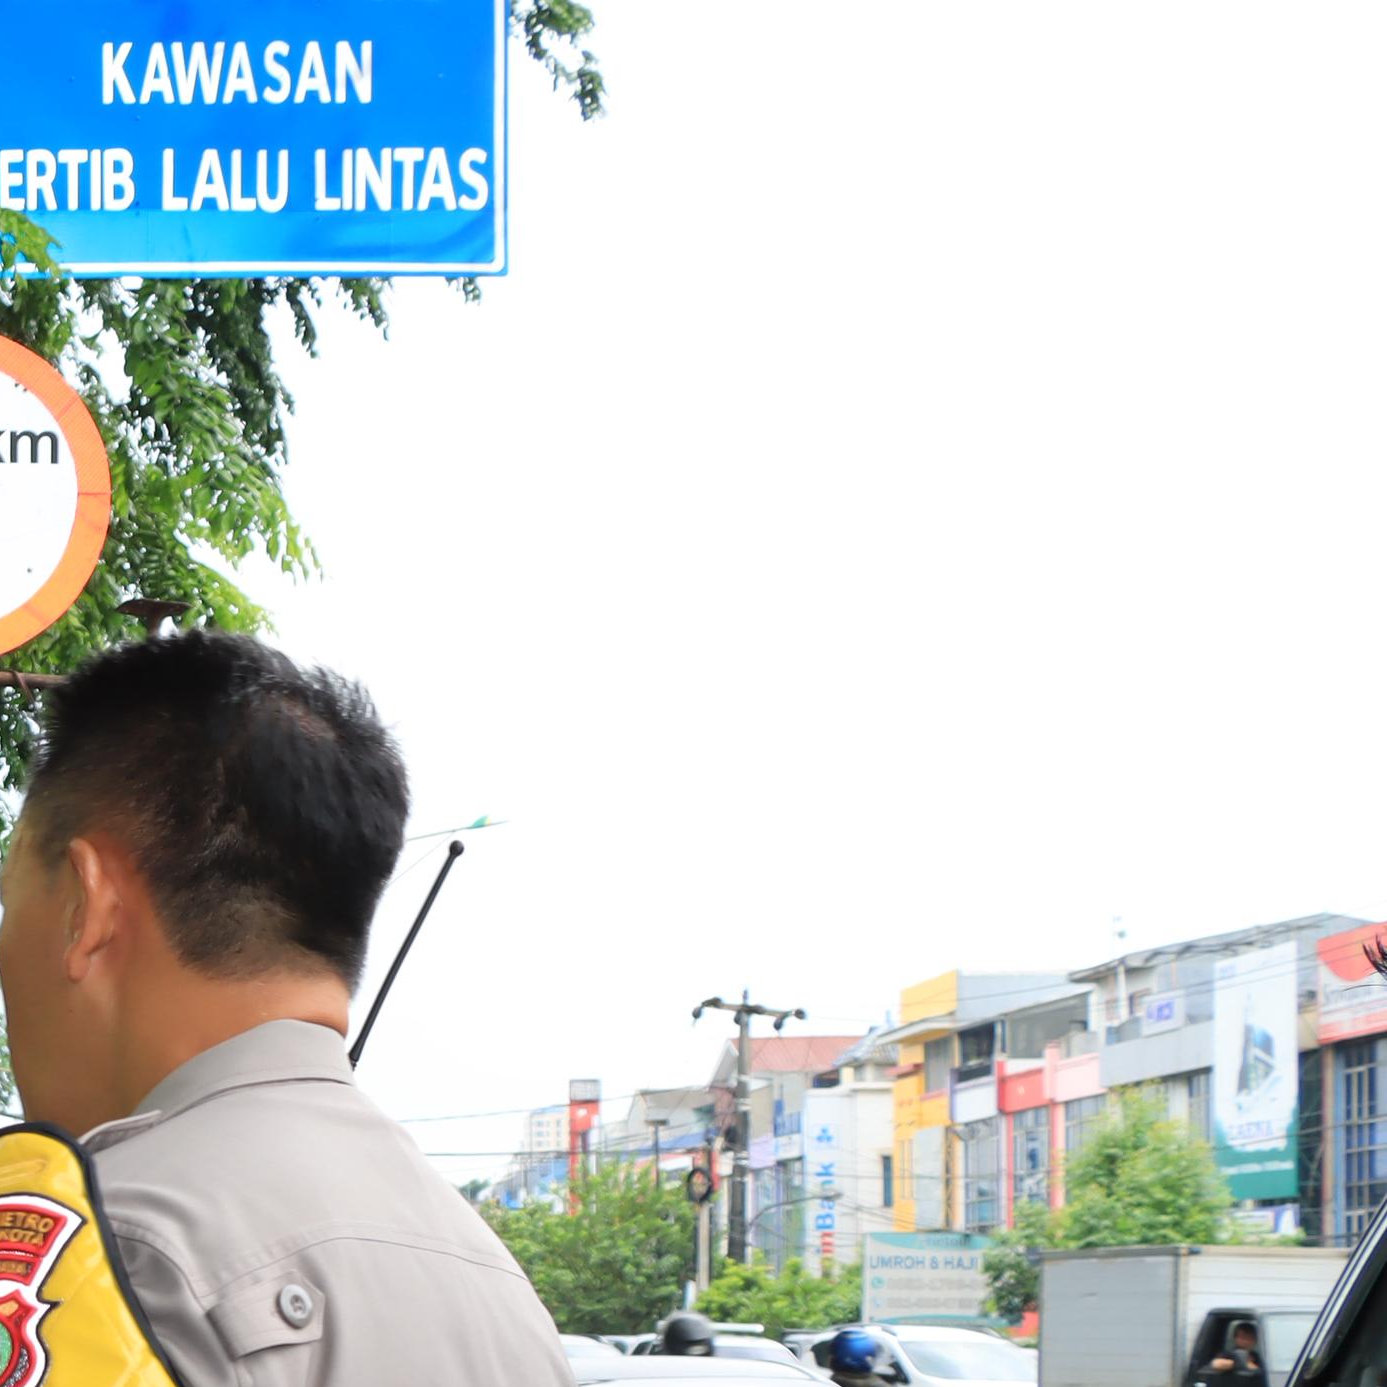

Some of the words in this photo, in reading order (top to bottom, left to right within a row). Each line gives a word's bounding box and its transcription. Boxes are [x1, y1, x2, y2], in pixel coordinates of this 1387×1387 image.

[101, 40, 373, 106] KAWASAN
[161, 149, 290, 213] LALU
[314, 147, 489, 213] LINTAS
[870, 1256, 925, 1269] UMROH
